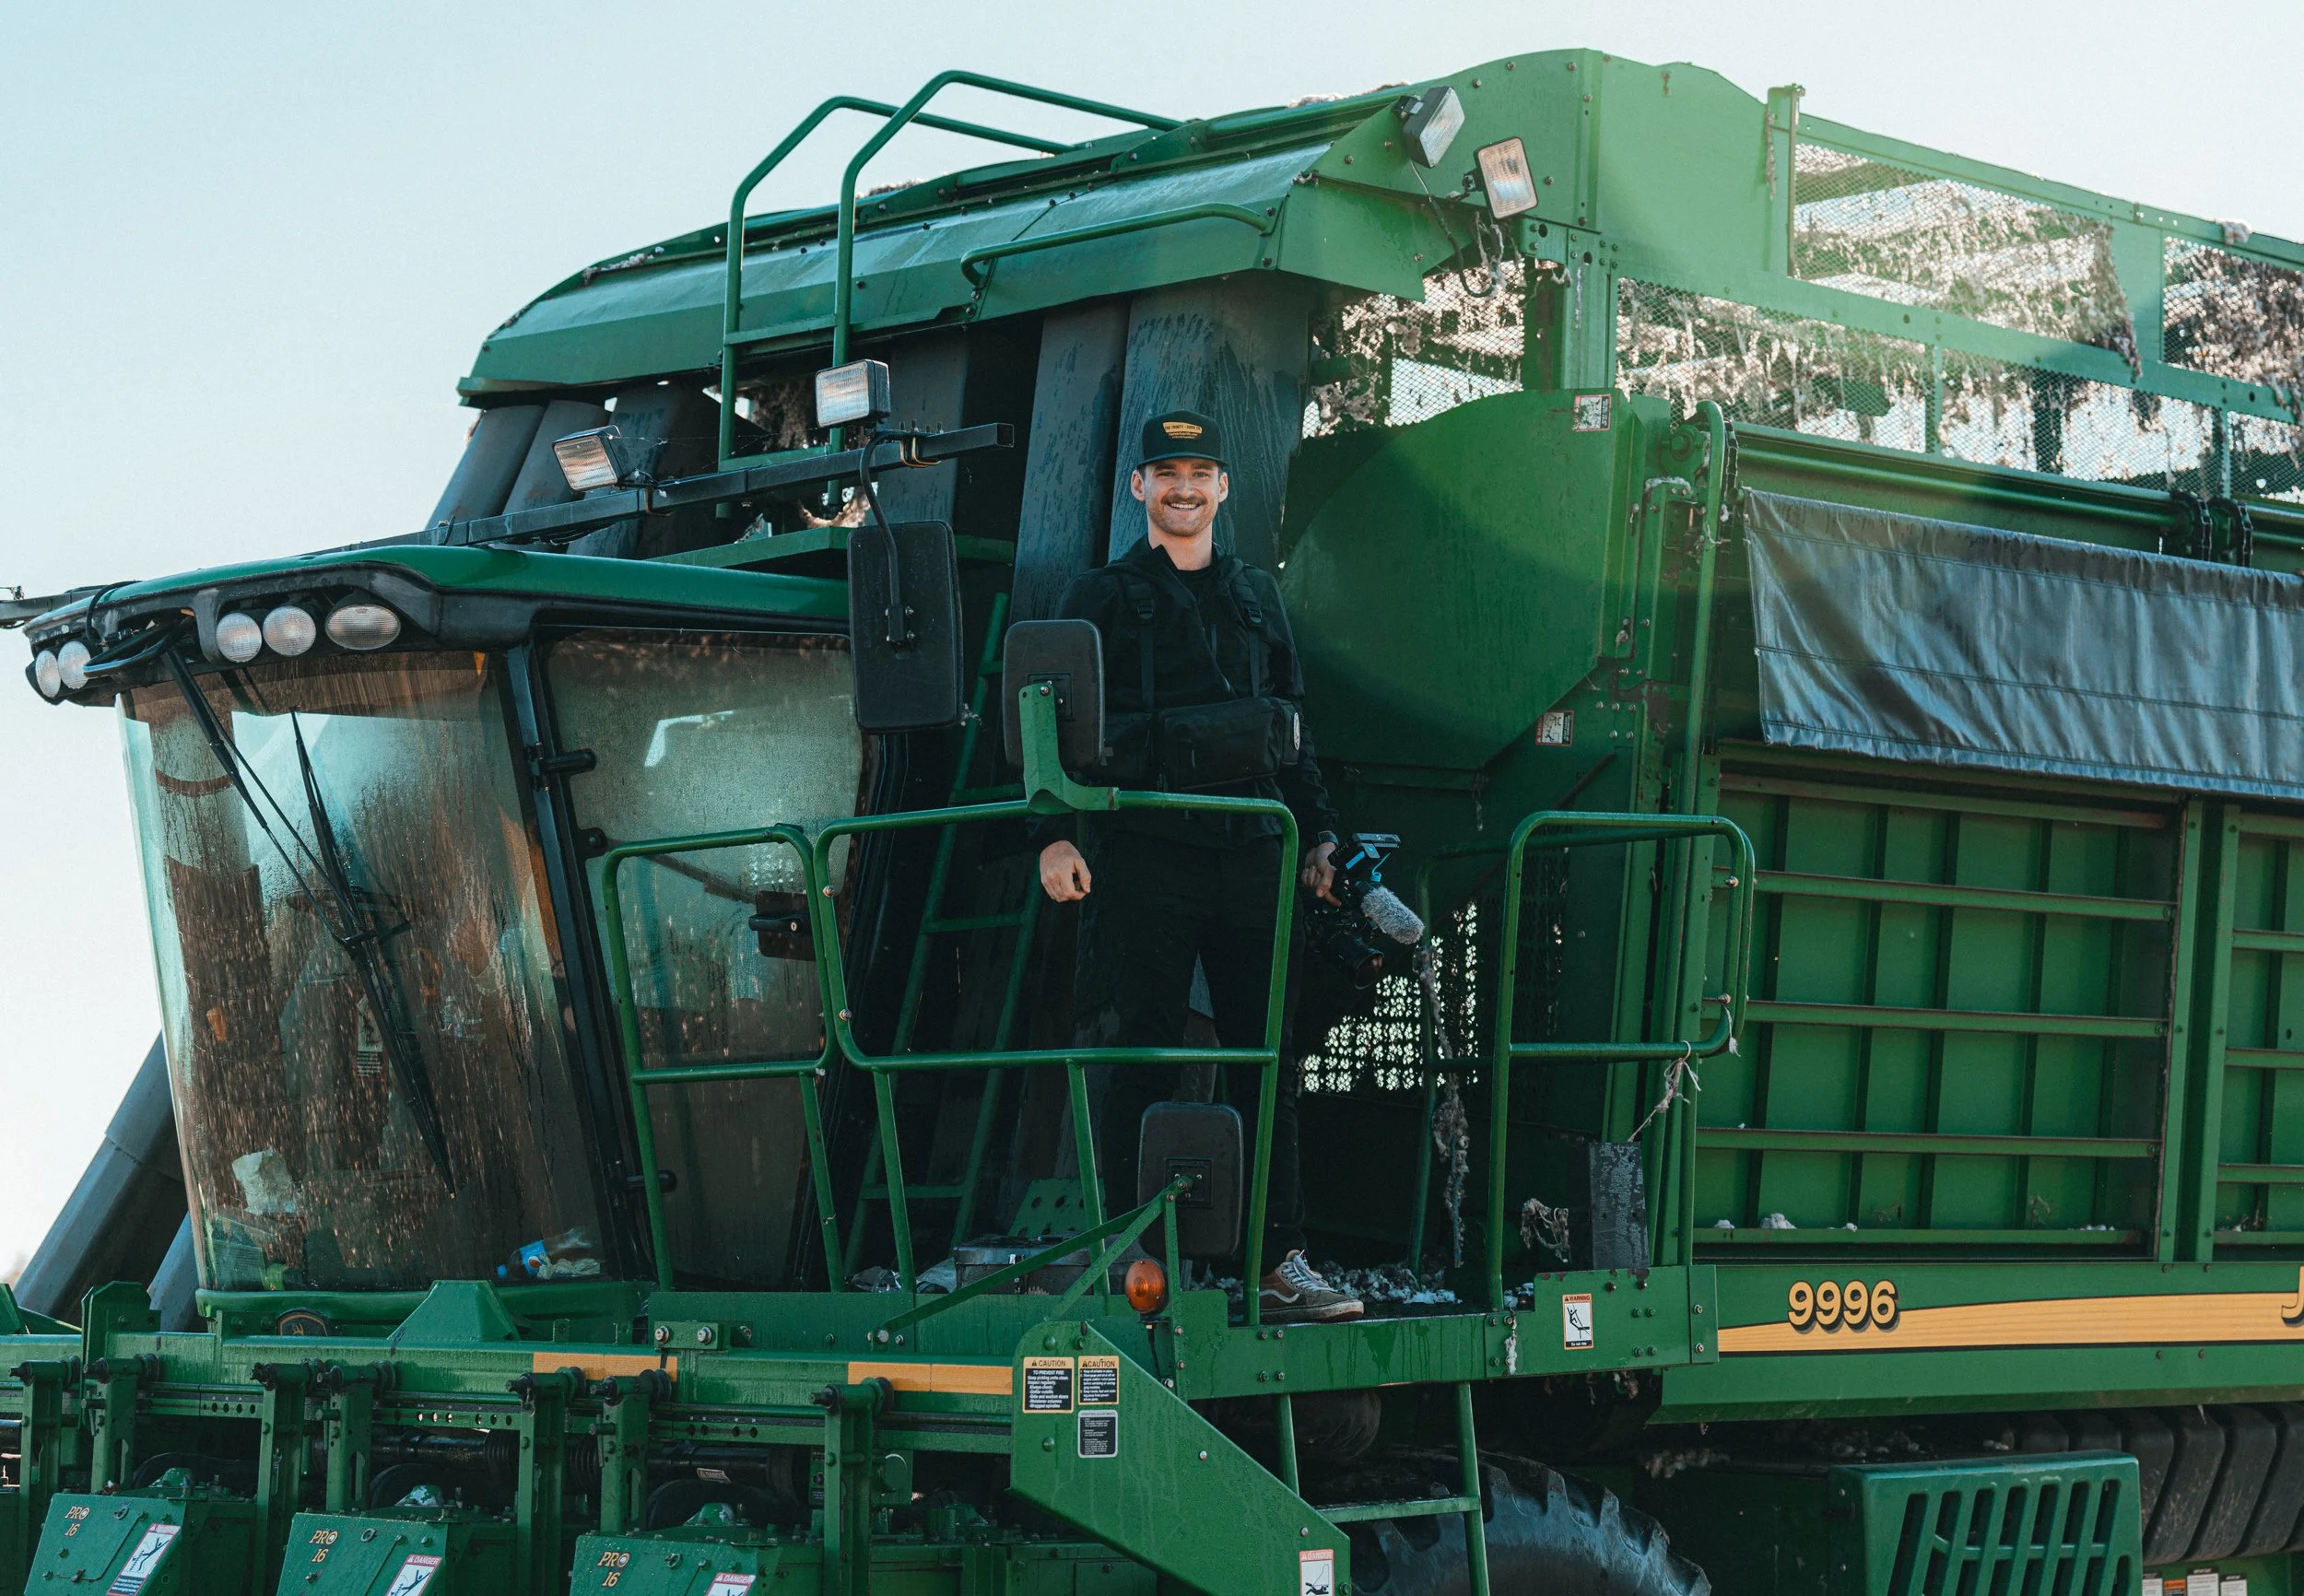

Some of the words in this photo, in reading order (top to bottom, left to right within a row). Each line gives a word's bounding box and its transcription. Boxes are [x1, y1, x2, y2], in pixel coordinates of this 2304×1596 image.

[1788, 1279, 1898, 1332] 9996
[64, 1506, 90, 1520] PRO
[65, 1523, 81, 1537] 16
[309, 1530, 338, 1545] PRO
[312, 1548, 329, 1563] 16
[413, 1556, 439, 1565] DANGER
[597, 1551, 630, 1568] PRO
[602, 1571, 620, 1587] 16
[723, 1574, 755, 1583] DANGER
